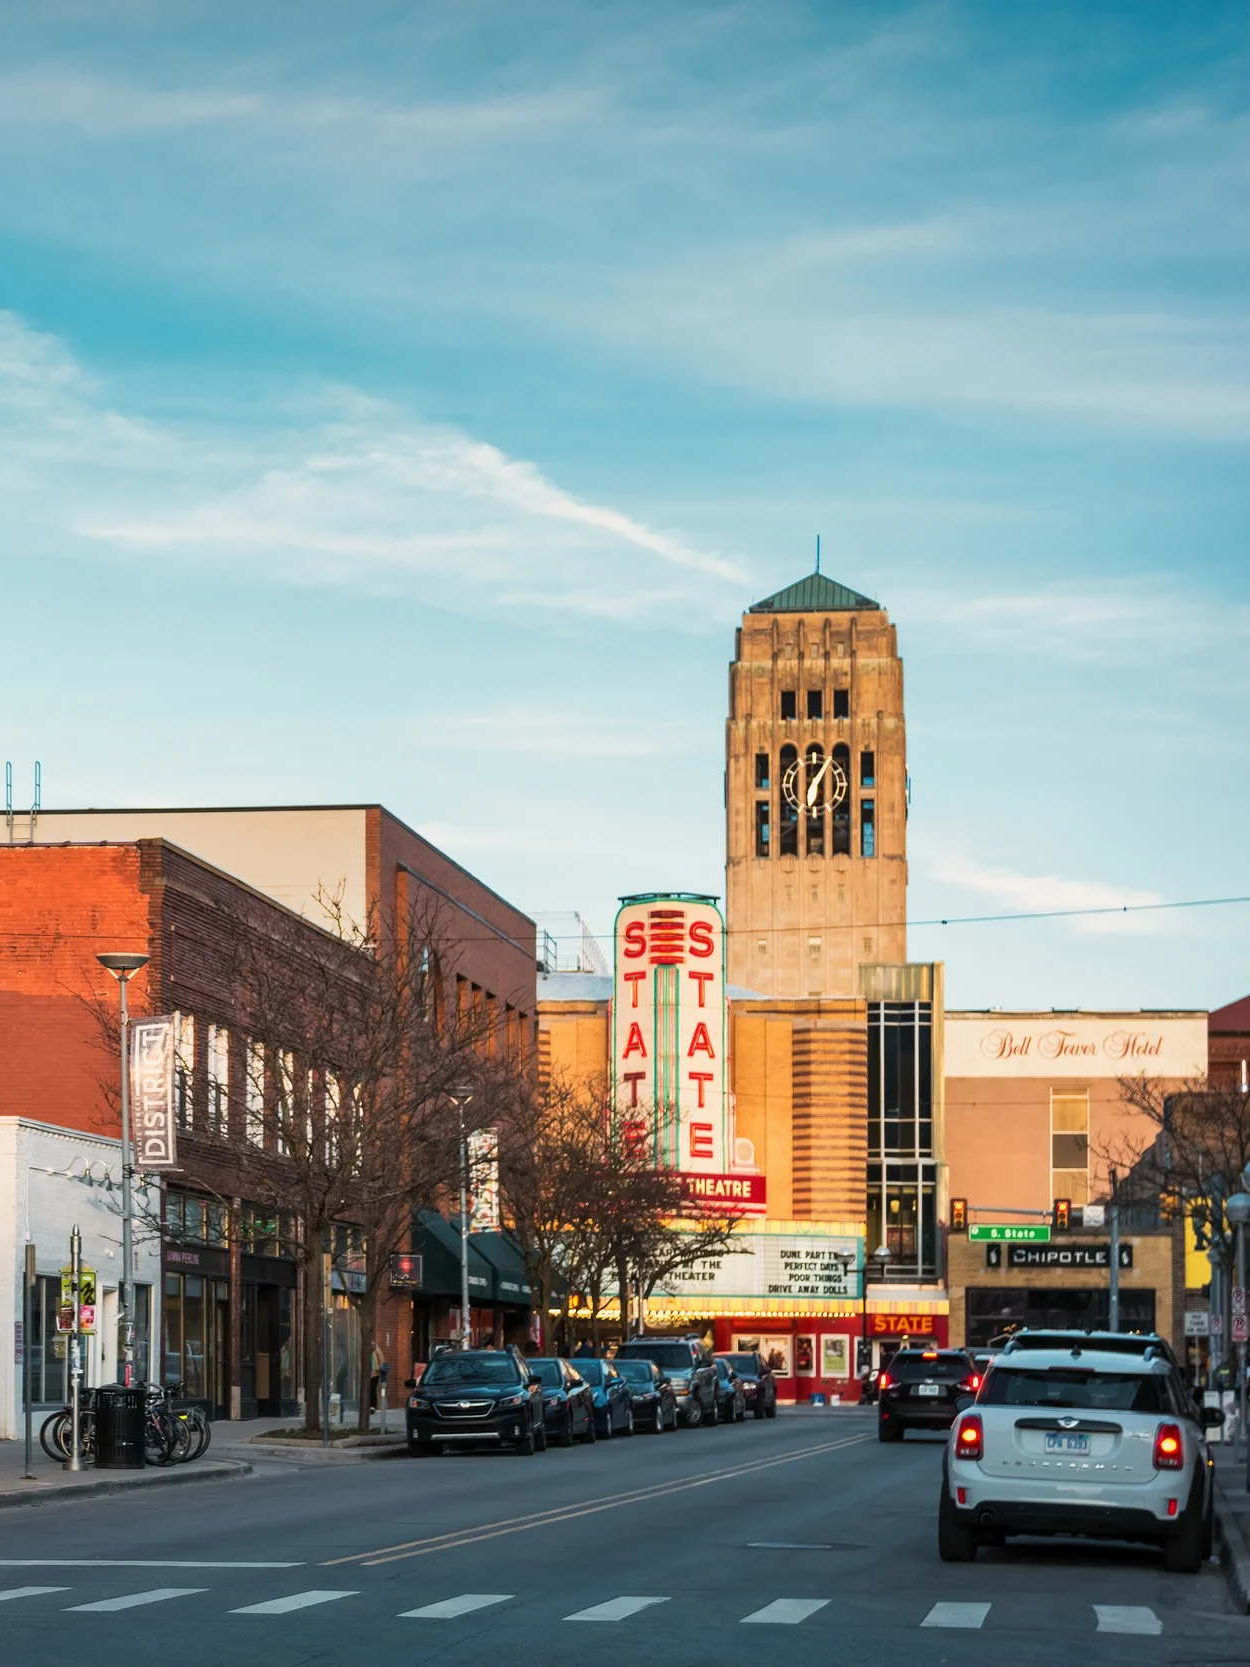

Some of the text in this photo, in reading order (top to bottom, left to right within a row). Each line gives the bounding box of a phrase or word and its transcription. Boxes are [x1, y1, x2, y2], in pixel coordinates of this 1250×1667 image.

[687, 920, 716, 1158] STATE
[980, 1029, 1164, 1061] Bell Tower Hotel
[142, 1031, 166, 1157] DISTRICT
[687, 1178, 752, 1198] THEATRE
[1005, 1229, 1035, 1238] State
[780, 1250, 801, 1259] DUNE
[805, 1251, 825, 1260] PART
[1013, 1250, 1107, 1263] CHIPOTLE
[702, 1261, 722, 1269] THE
[784, 1262, 839, 1271] PERFECT DAYS
[669, 1272, 716, 1280] THEATER
[789, 1273, 842, 1283] POOR THINGS
[768, 1285, 792, 1293] DRIVE
[823, 1286, 847, 1294] DOLLS
[874, 1314, 932, 1332] STATE
